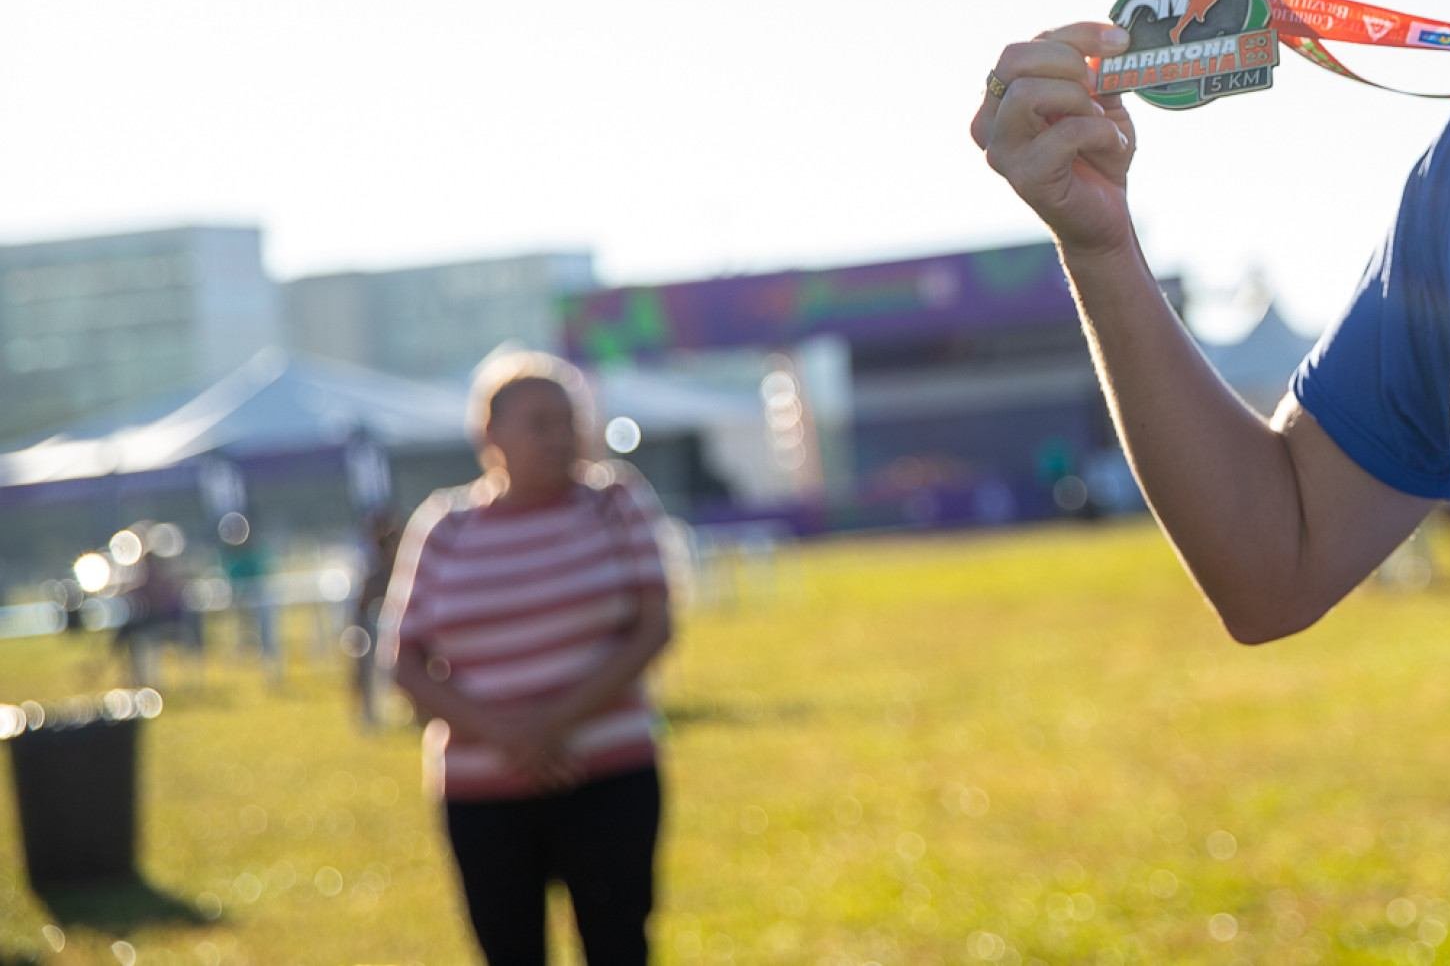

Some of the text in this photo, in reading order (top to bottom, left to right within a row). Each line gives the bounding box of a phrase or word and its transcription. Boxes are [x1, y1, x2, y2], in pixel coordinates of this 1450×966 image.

[1102, 39, 1236, 74] MARATONA
[1211, 69, 1260, 92] 5 KM
